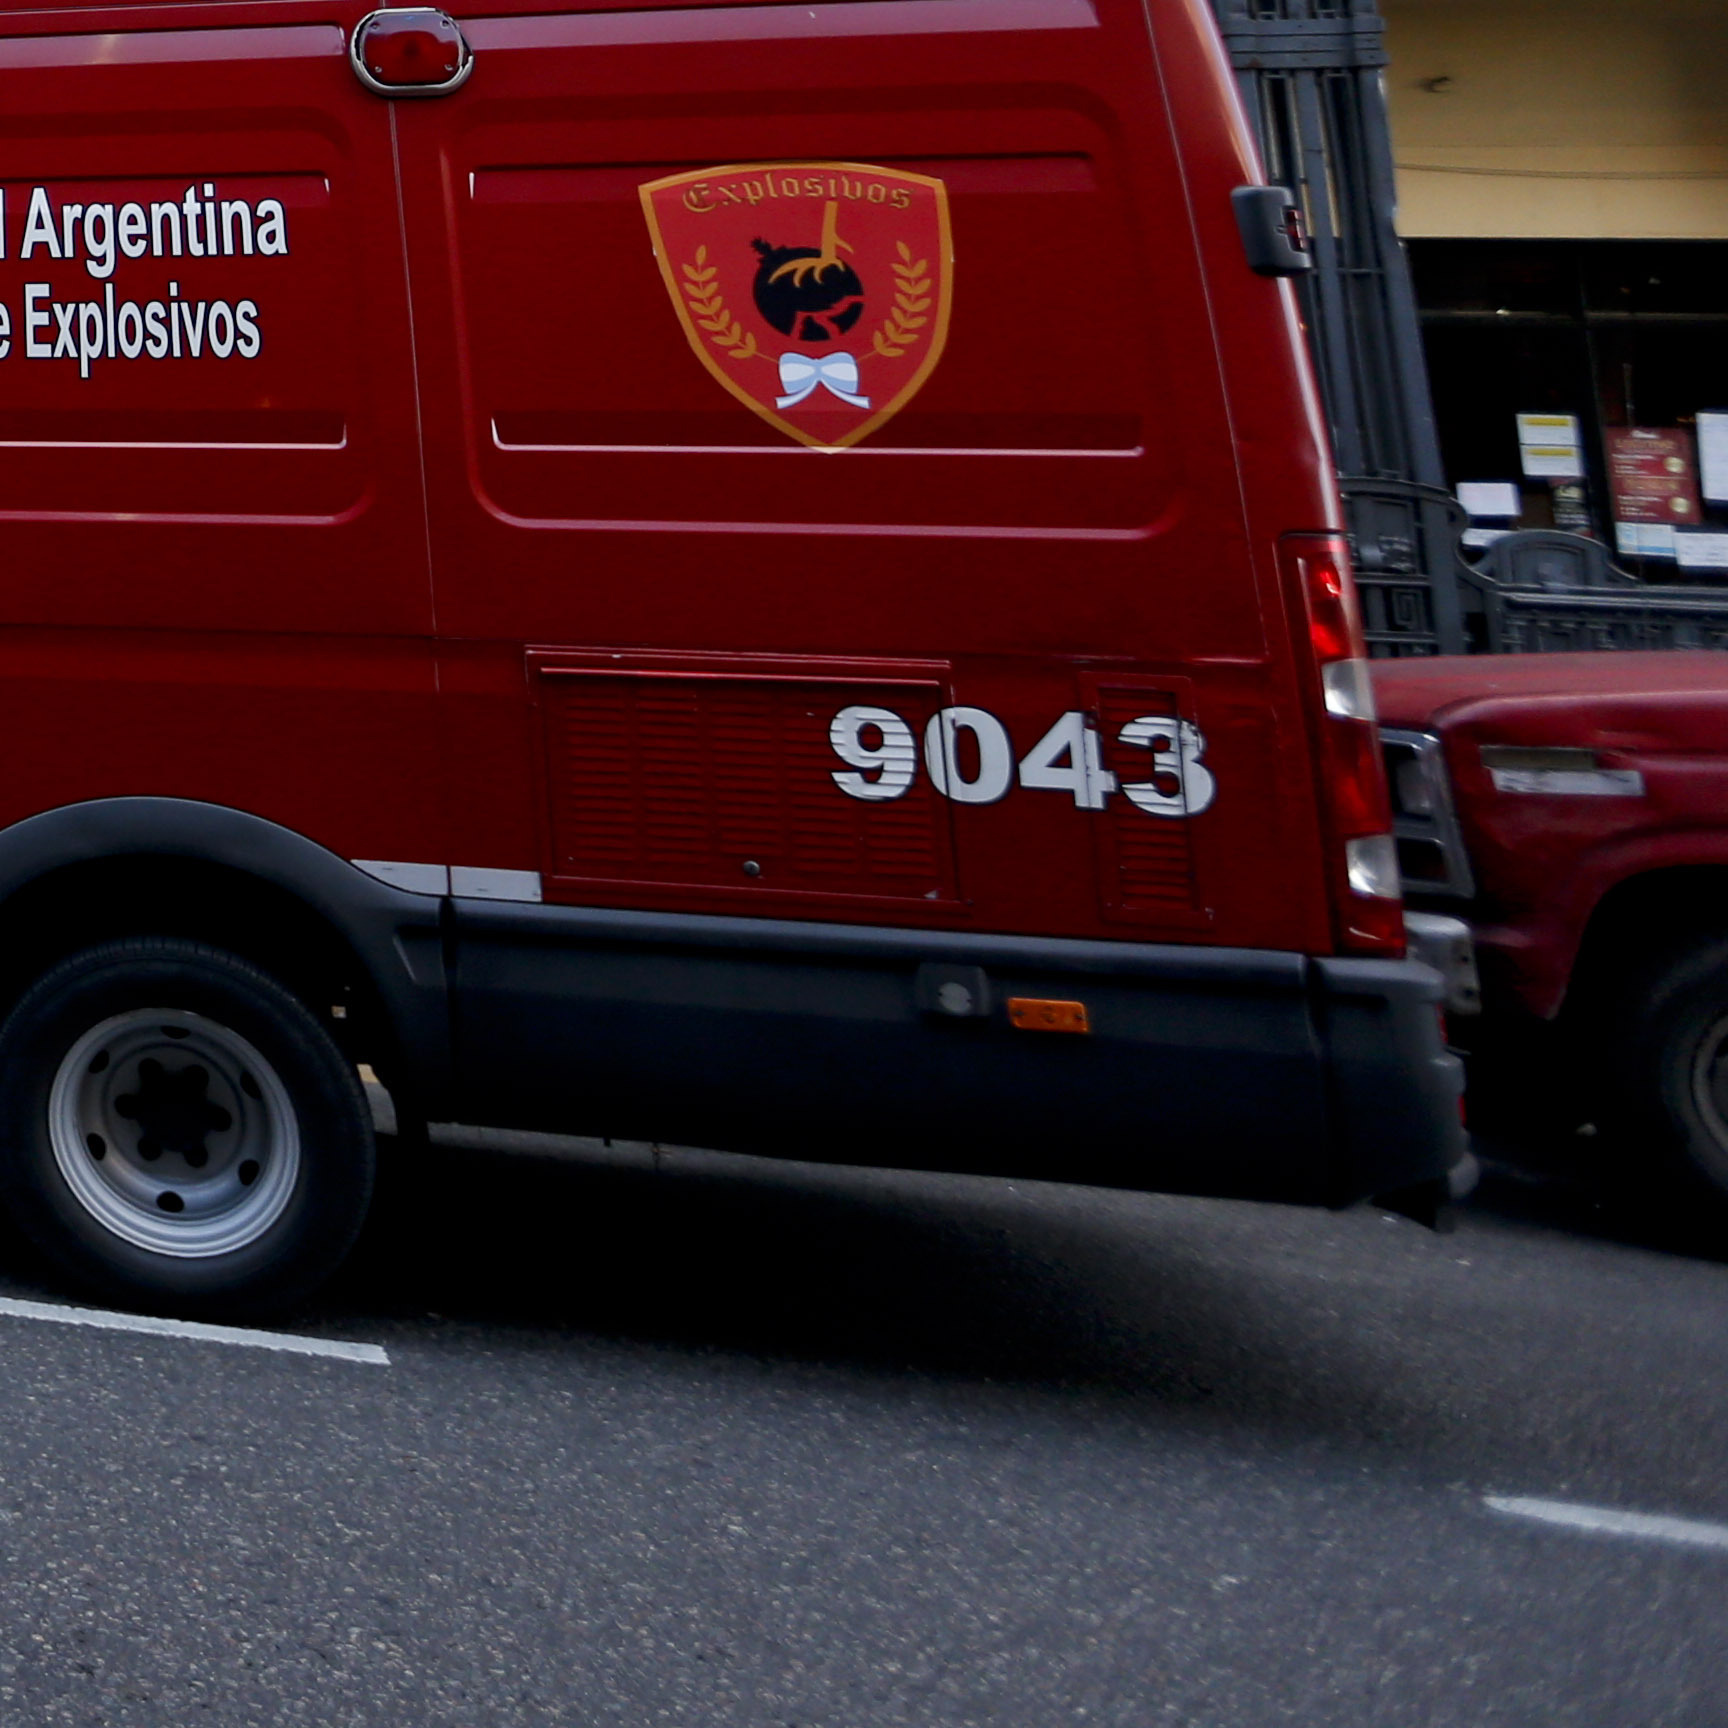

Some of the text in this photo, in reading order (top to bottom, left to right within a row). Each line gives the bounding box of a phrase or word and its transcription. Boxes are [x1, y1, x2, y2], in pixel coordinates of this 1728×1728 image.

[20, 182, 289, 279] Argentina
[682, 173, 915, 213] Explosivos
[23, 281, 261, 379] Explosivos
[828, 704, 1217, 818] 9043
